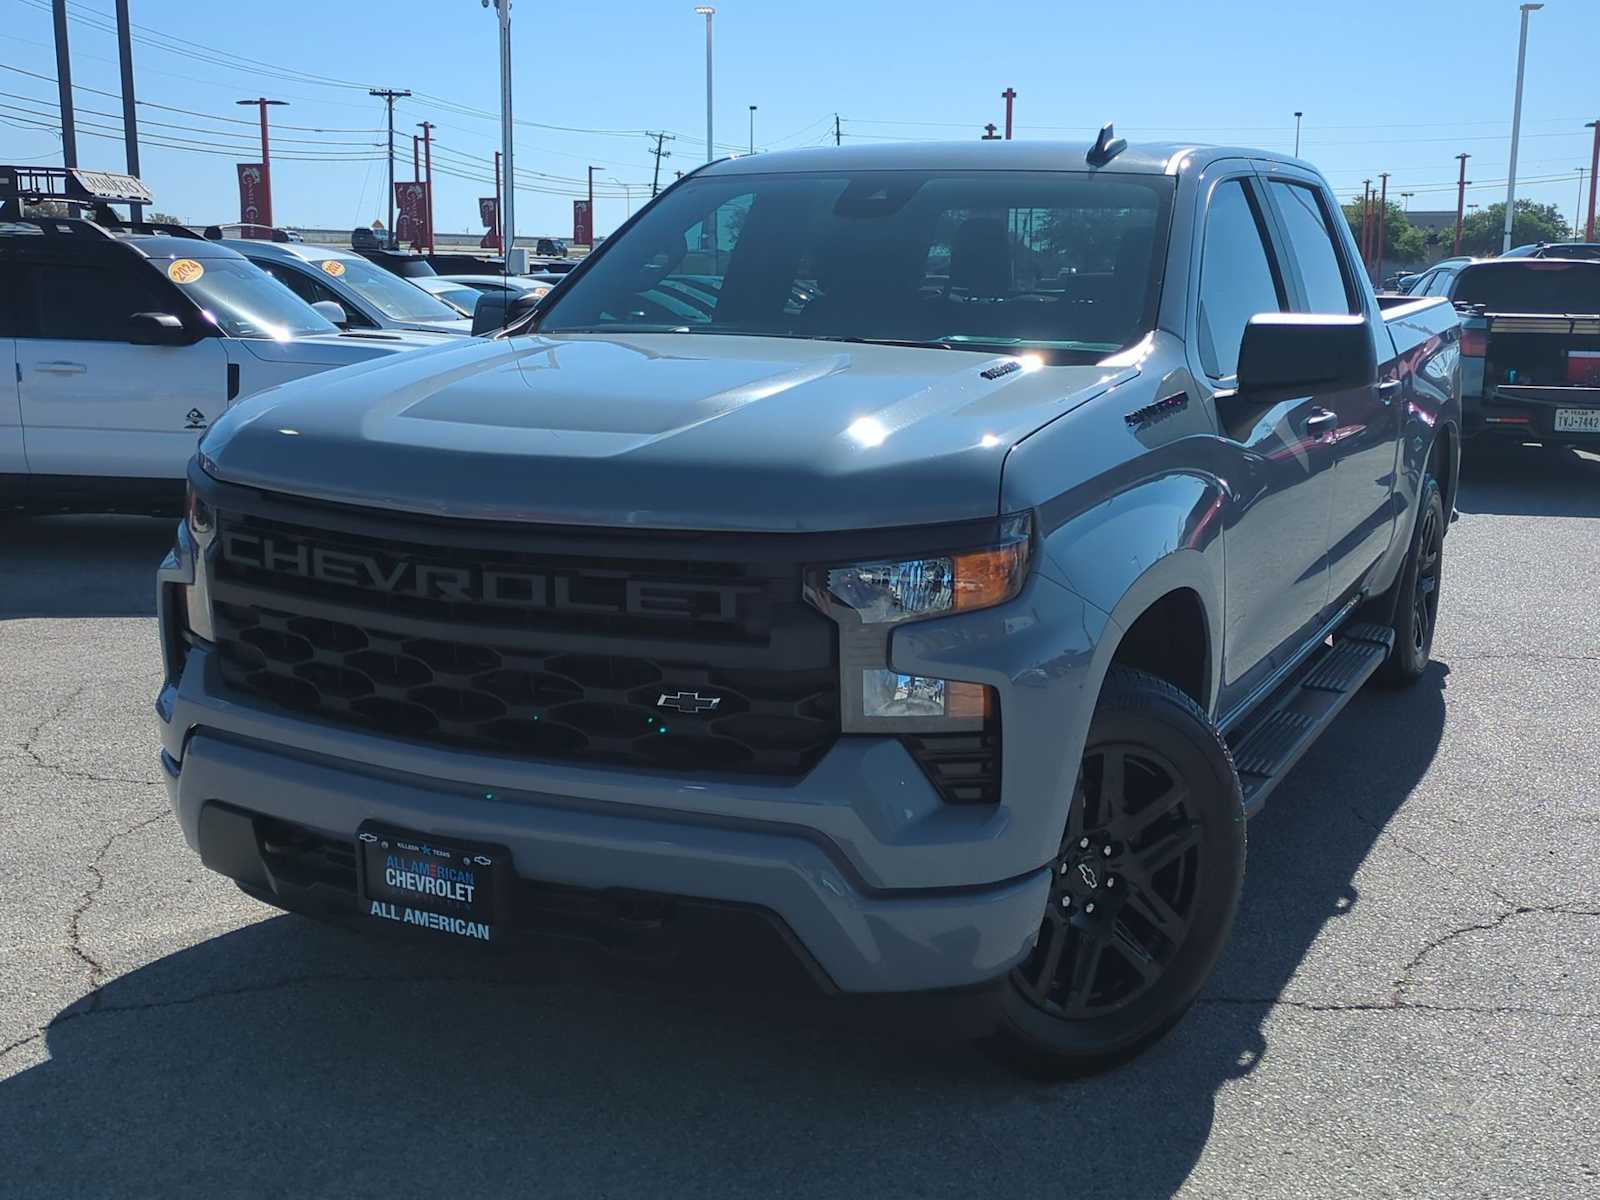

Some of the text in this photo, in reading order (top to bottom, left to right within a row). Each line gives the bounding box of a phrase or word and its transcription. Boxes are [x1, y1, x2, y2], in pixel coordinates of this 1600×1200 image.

[173, 261, 200, 281] 2024
[223, 533, 761, 619] CHEVROLET
[385, 868, 475, 903] CHEVROLET
[386, 855, 474, 885] ALL AMERICAN
[370, 901, 489, 941] ALL AMERICAN
